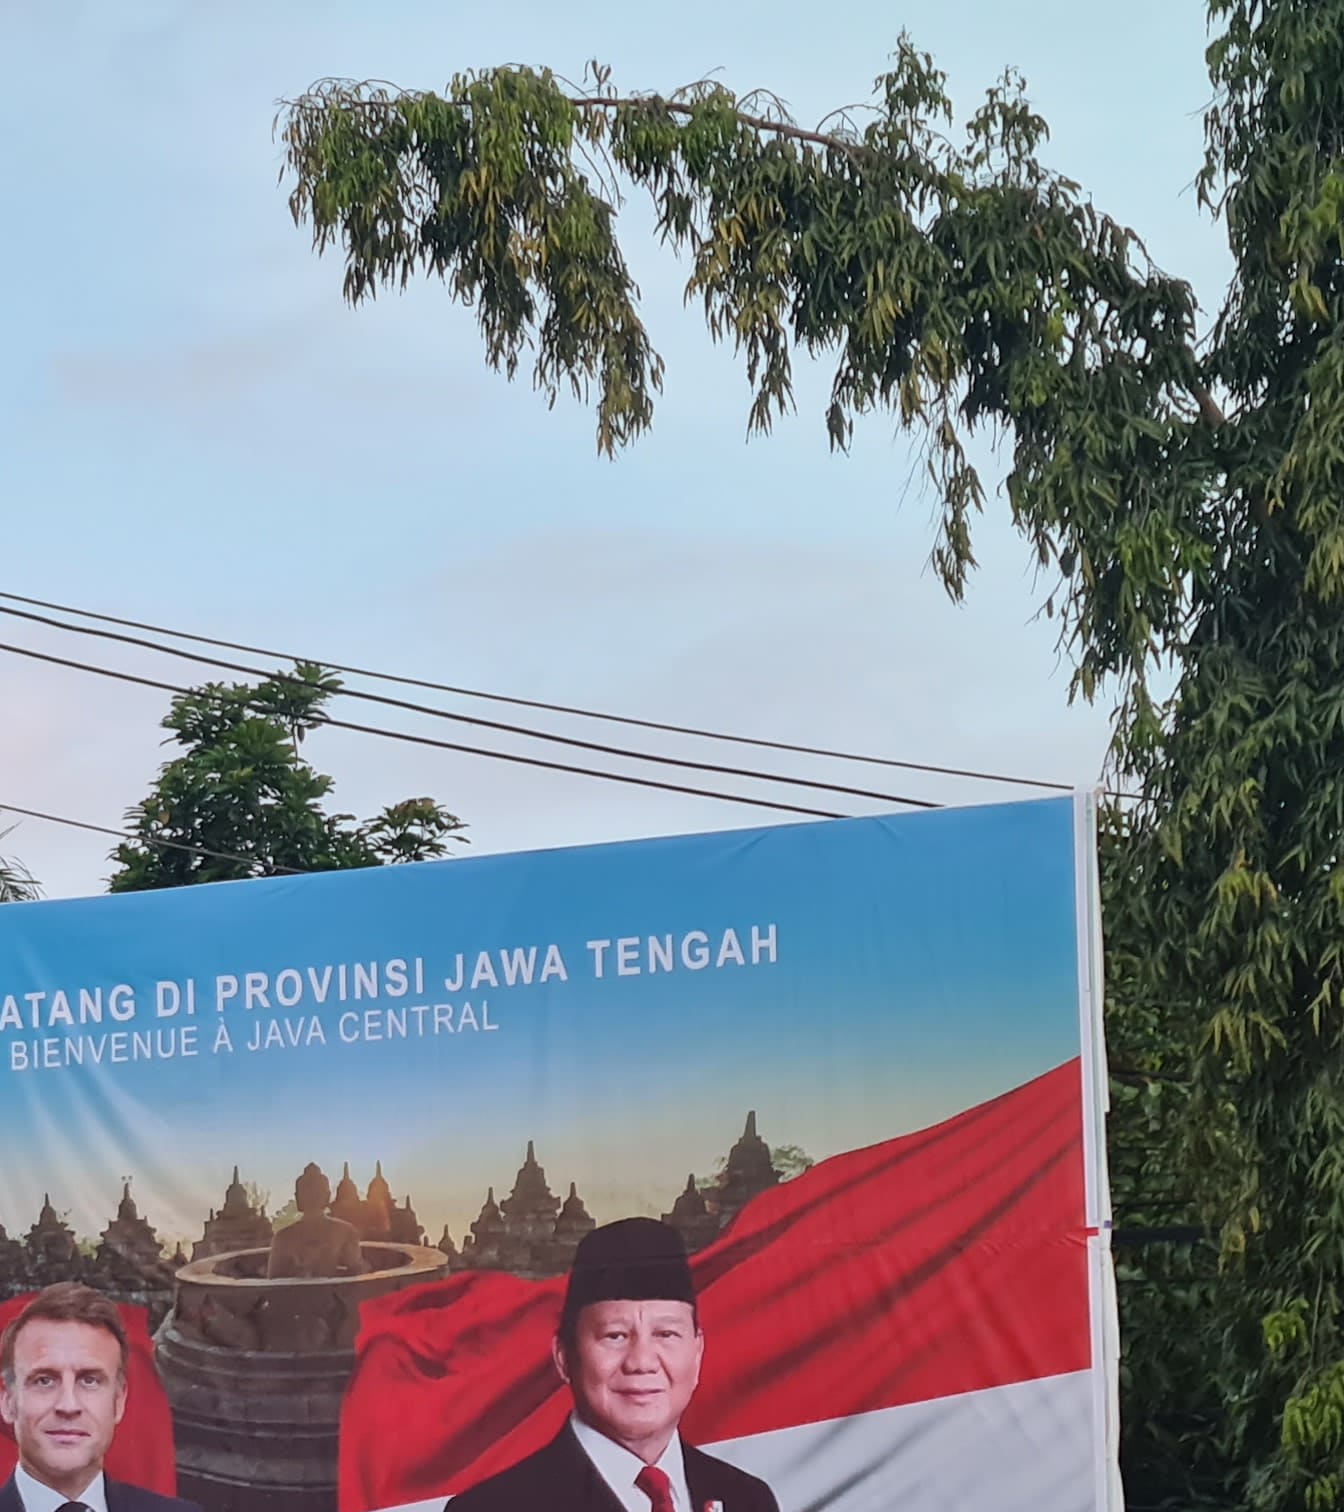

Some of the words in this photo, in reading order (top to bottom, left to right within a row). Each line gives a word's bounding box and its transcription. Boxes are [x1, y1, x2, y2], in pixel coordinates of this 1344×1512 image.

[156, 978, 194, 1017] DI
[216, 957, 424, 1011] PROVINSI
[445, 944, 568, 992] JAWA
[586, 924, 777, 978] TENGAH
[11, 1026, 199, 1071] BIENVENUE
[213, 1017, 233, 1053] À
[247, 1015, 325, 1051] JAVA
[338, 1000, 499, 1043] CENTRAL
